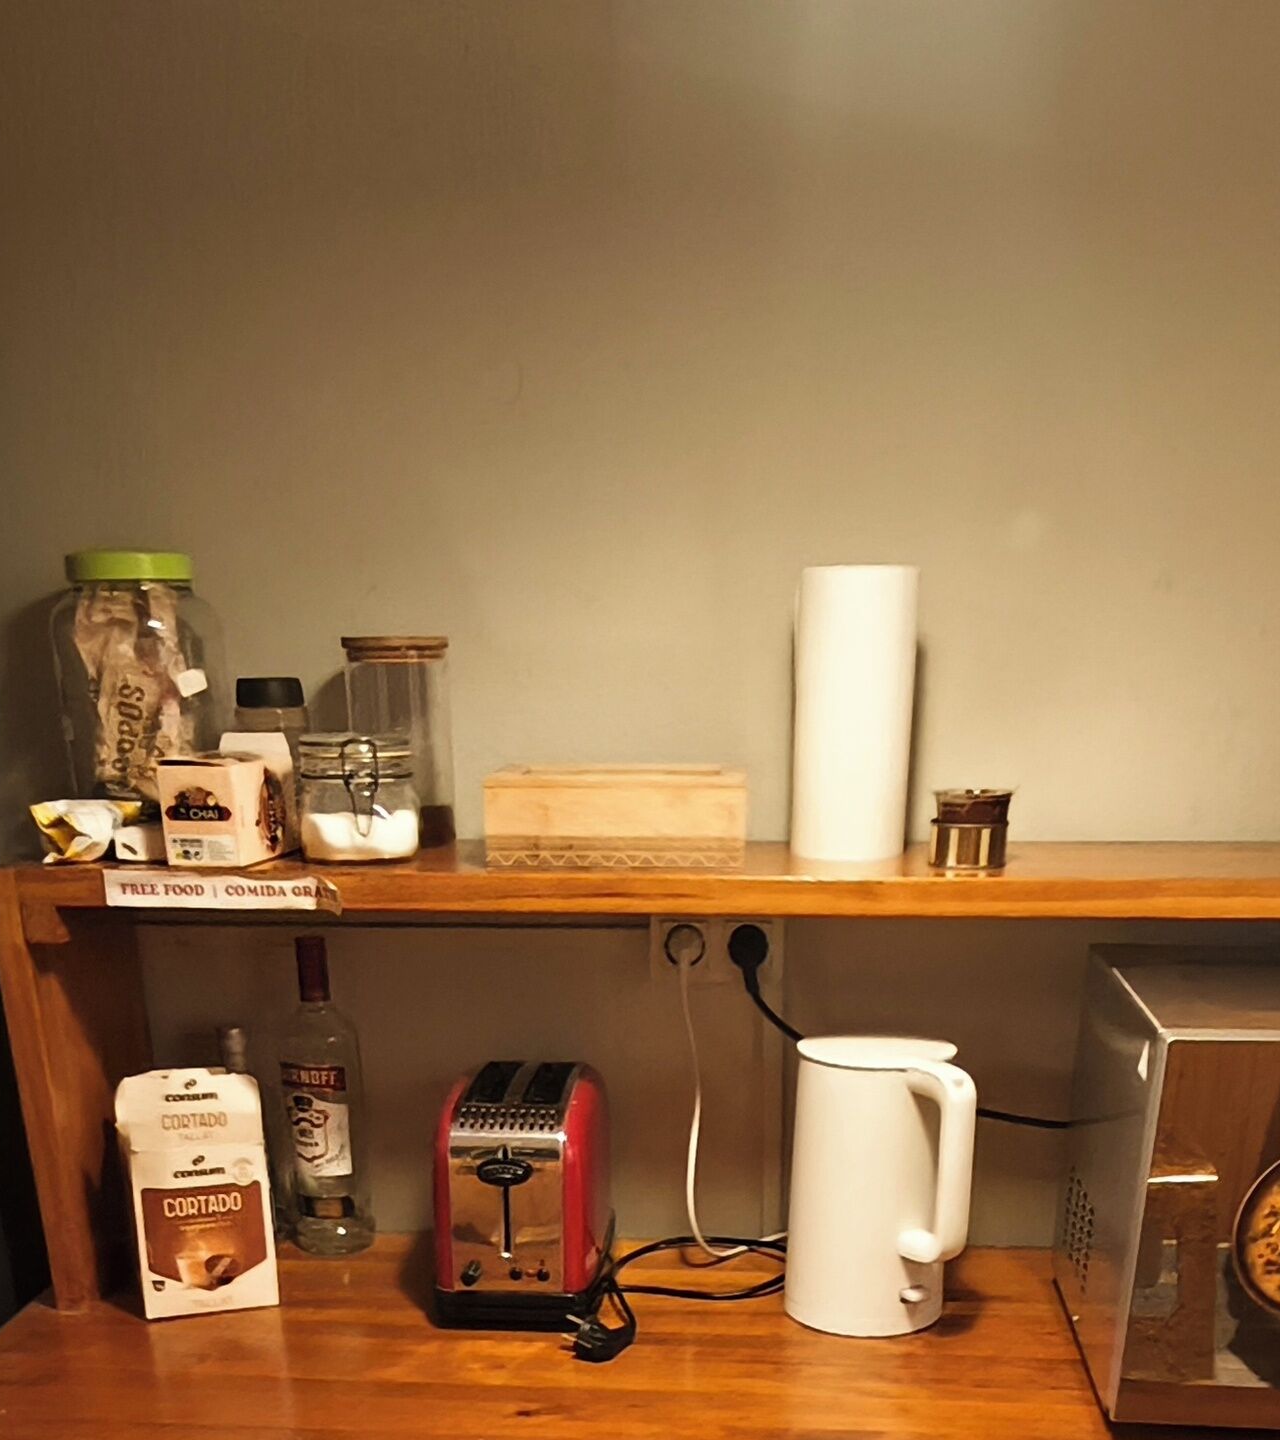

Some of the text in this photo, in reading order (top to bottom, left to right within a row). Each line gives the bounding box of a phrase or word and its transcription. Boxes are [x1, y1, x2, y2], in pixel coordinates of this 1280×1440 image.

[121, 883, 159, 896] FREE
[164, 884, 204, 896] FOOD
[225, 885, 286, 897] COMIDA
[161, 1112, 228, 1131] CORTADO
[163, 1191, 242, 1218] CORTADO
